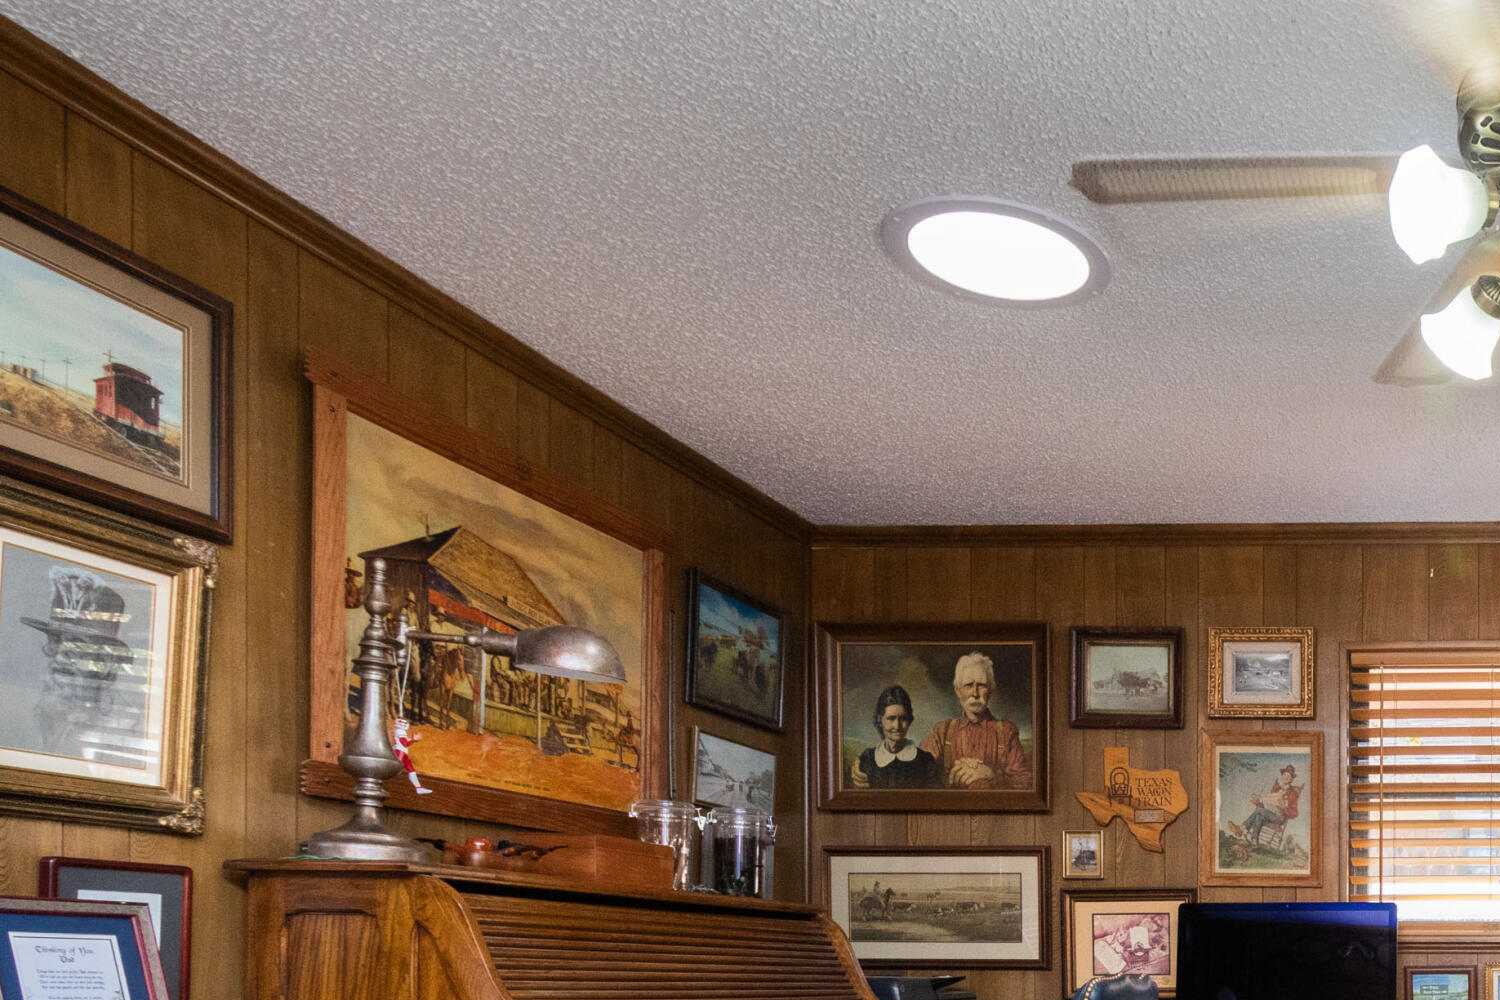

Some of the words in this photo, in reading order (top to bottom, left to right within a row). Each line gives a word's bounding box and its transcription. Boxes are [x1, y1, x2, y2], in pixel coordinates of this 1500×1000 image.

[1135, 777, 1173, 787] TEXAS
[1137, 787, 1171, 797] WAGON
[1135, 796, 1172, 807] TRAIN
